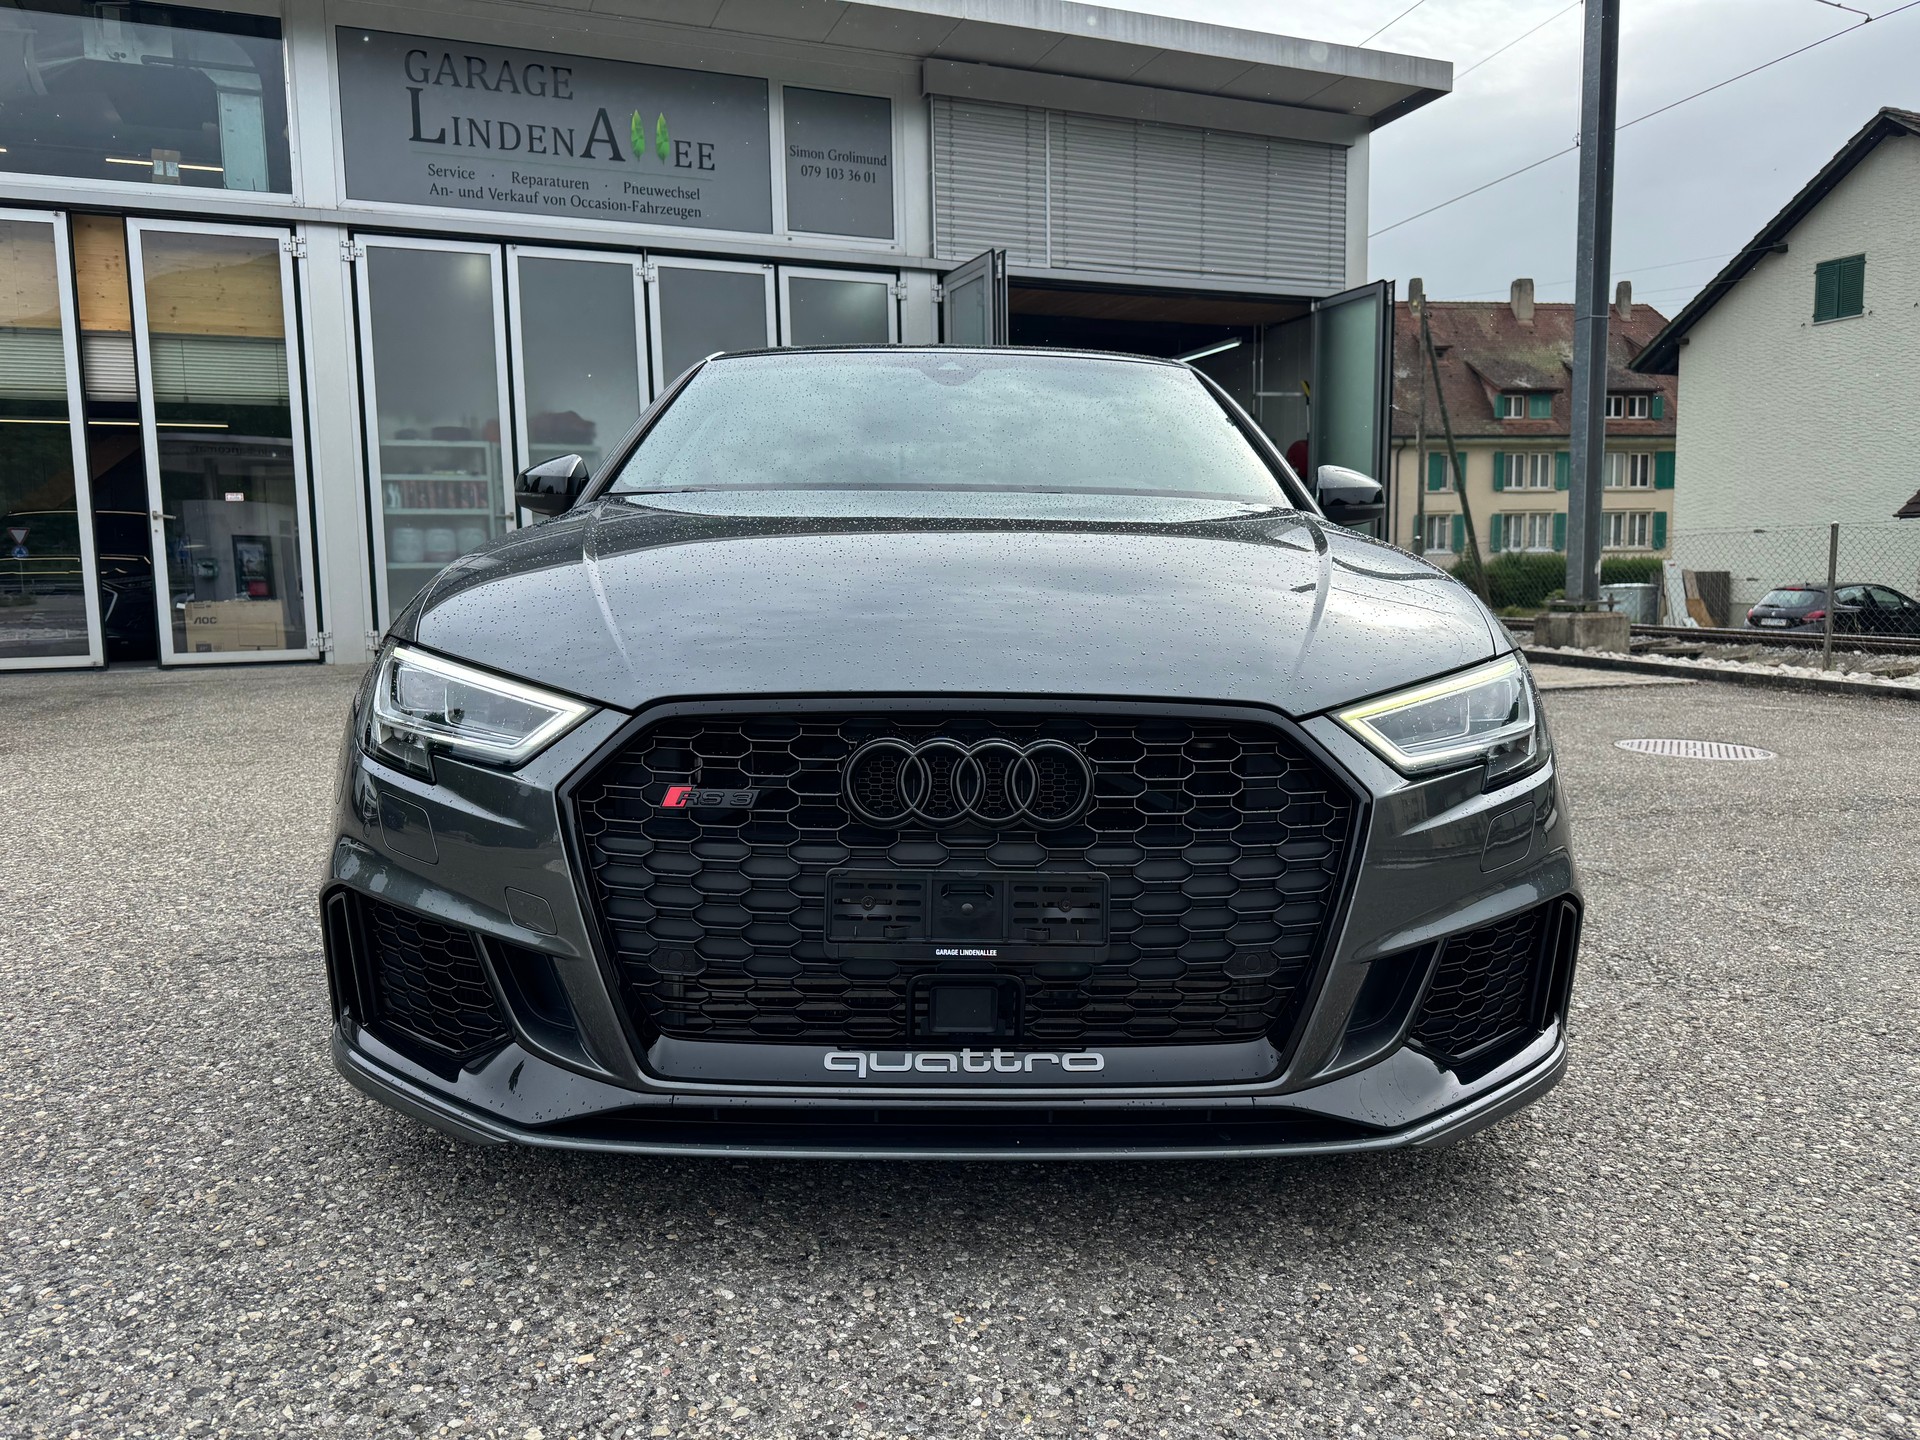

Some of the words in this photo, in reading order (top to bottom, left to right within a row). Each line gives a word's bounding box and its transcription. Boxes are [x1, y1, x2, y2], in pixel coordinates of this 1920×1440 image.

[404, 49, 574, 100] GARAGE
[405, 86, 716, 171] LINDENAEE
[789, 144, 825, 160] Simon
[827, 148, 887, 167] Grolimund
[427, 163, 476, 180] Service
[511, 171, 590, 190] Reparaturen
[623, 181, 701, 201] Pneuwechsel
[800, 164, 822, 178] 079
[826, 167, 845, 181] 103
[848, 169, 861, 182] 36
[863, 171, 876, 184] 01
[429, 182, 454, 197] An-
[458, 186, 484, 200] und
[488, 187, 540, 204] Verkauf
[542, 194, 567, 207] von
[570, 194, 702, 221] Occasion-Fahrzeugen
[193, 616, 218, 625] AOC
[675, 790, 725, 806] RS
[935, 948, 959, 956] GARAGE
[959, 949, 998, 957] LINDENALLEE
[823, 1048, 1105, 1079] quattro
